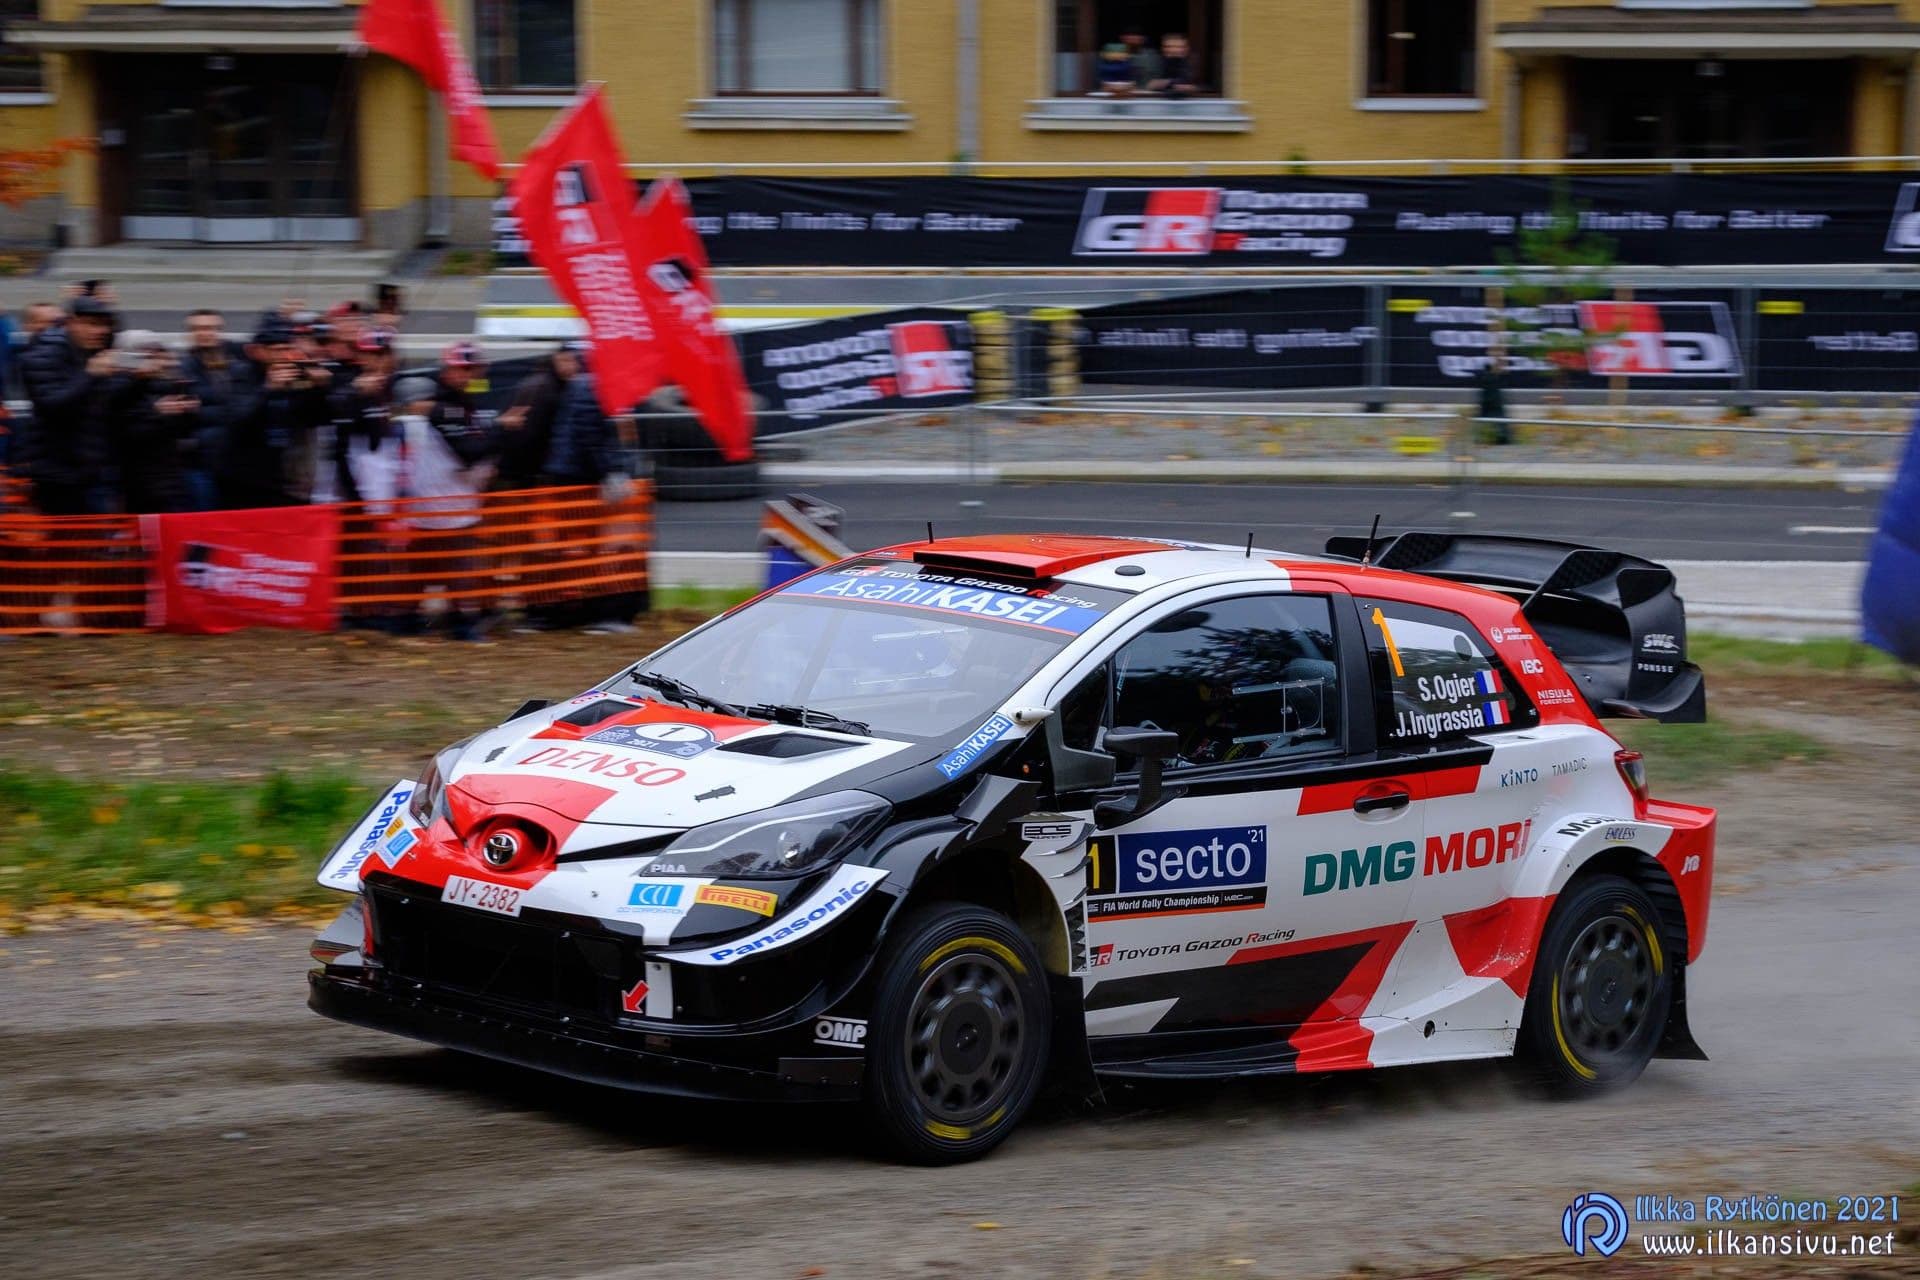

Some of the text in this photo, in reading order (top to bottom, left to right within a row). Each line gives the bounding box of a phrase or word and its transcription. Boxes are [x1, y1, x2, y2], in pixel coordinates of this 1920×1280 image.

[1082, 215, 1209, 250] GR
[813, 577, 1070, 625] AsahiKASEI
[880, 570, 951, 583] TOYOTA
[954, 577, 1028, 595] GAZOO
[1028, 589, 1098, 610] Racing
[1371, 608, 1405, 676] 1
[1418, 673, 1475, 703] S.Ogier
[1537, 689, 1573, 699] NISULA
[658, 727, 685, 737] 1
[1396, 704, 1485, 738] J.Ingrassia
[942, 717, 1009, 777] AsahiKASEI
[516, 747, 687, 786] DENSO
[330, 790, 412, 878] Panasonic
[1605, 827, 1637, 839] ENDLESS
[651, 864, 687, 873] PIAA
[1088, 843, 1100, 889] 1
[1136, 837, 1250, 883] secto
[1303, 840, 1416, 896] DMG
[703, 888, 771, 910] PIRELLI
[1103, 902, 1116, 912] FIA
[1118, 900, 1140, 910] World
[1141, 898, 1162, 910] Rally
[1164, 894, 1219, 908] Championship
[710, 880, 870, 961] Panasonic
[1117, 944, 1183, 961] TOYOTA
[1184, 937, 1243, 953] GAZOO
[1245, 928, 1296, 945] Racing
[815, 1020, 867, 1042] OMP
